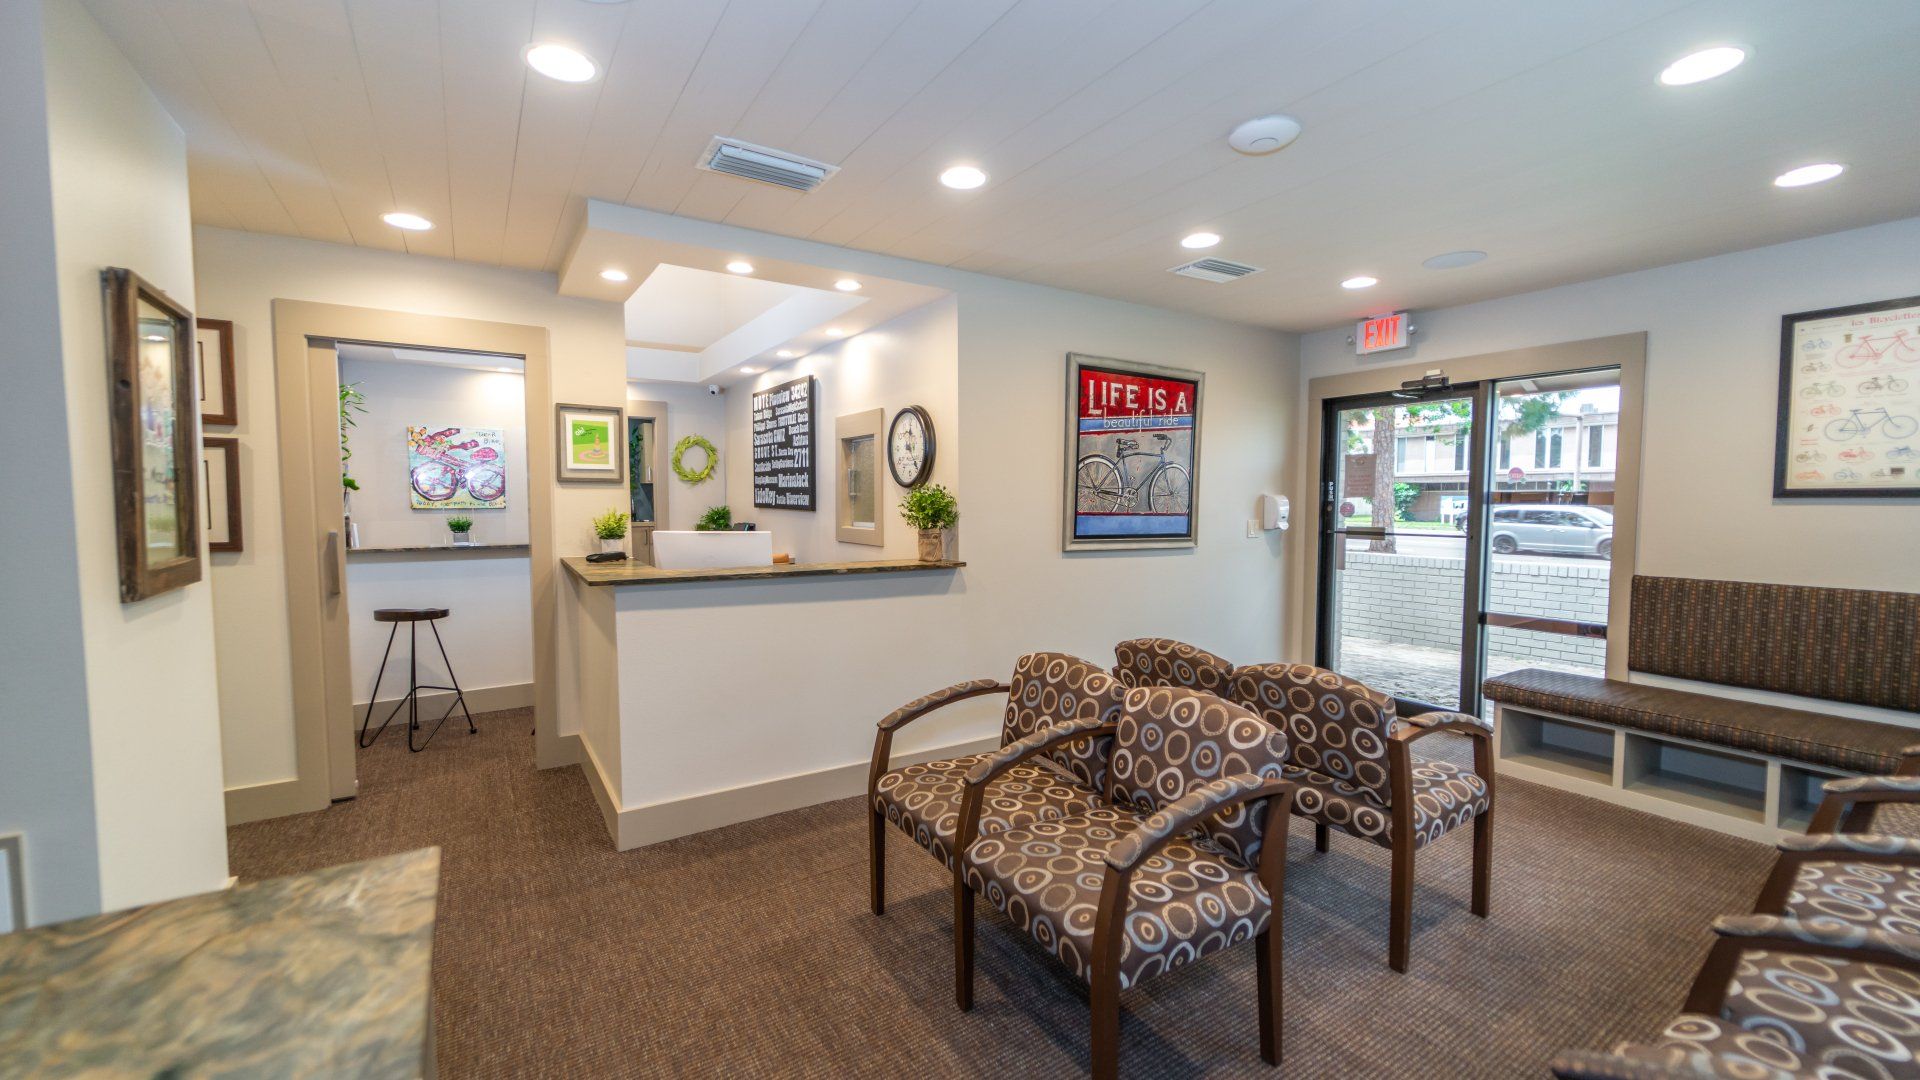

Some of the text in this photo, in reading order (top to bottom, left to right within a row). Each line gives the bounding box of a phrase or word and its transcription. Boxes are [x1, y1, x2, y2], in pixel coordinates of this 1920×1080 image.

[1365, 315, 1401, 349] EXIT
[1088, 379, 1188, 415] LIFE IS A
[1103, 406, 1179, 432] beautiful ride
[793, 447, 809, 468] 2711
[778, 472, 809, 488] MarinaJack
[786, 492, 810, 506] Riverview
